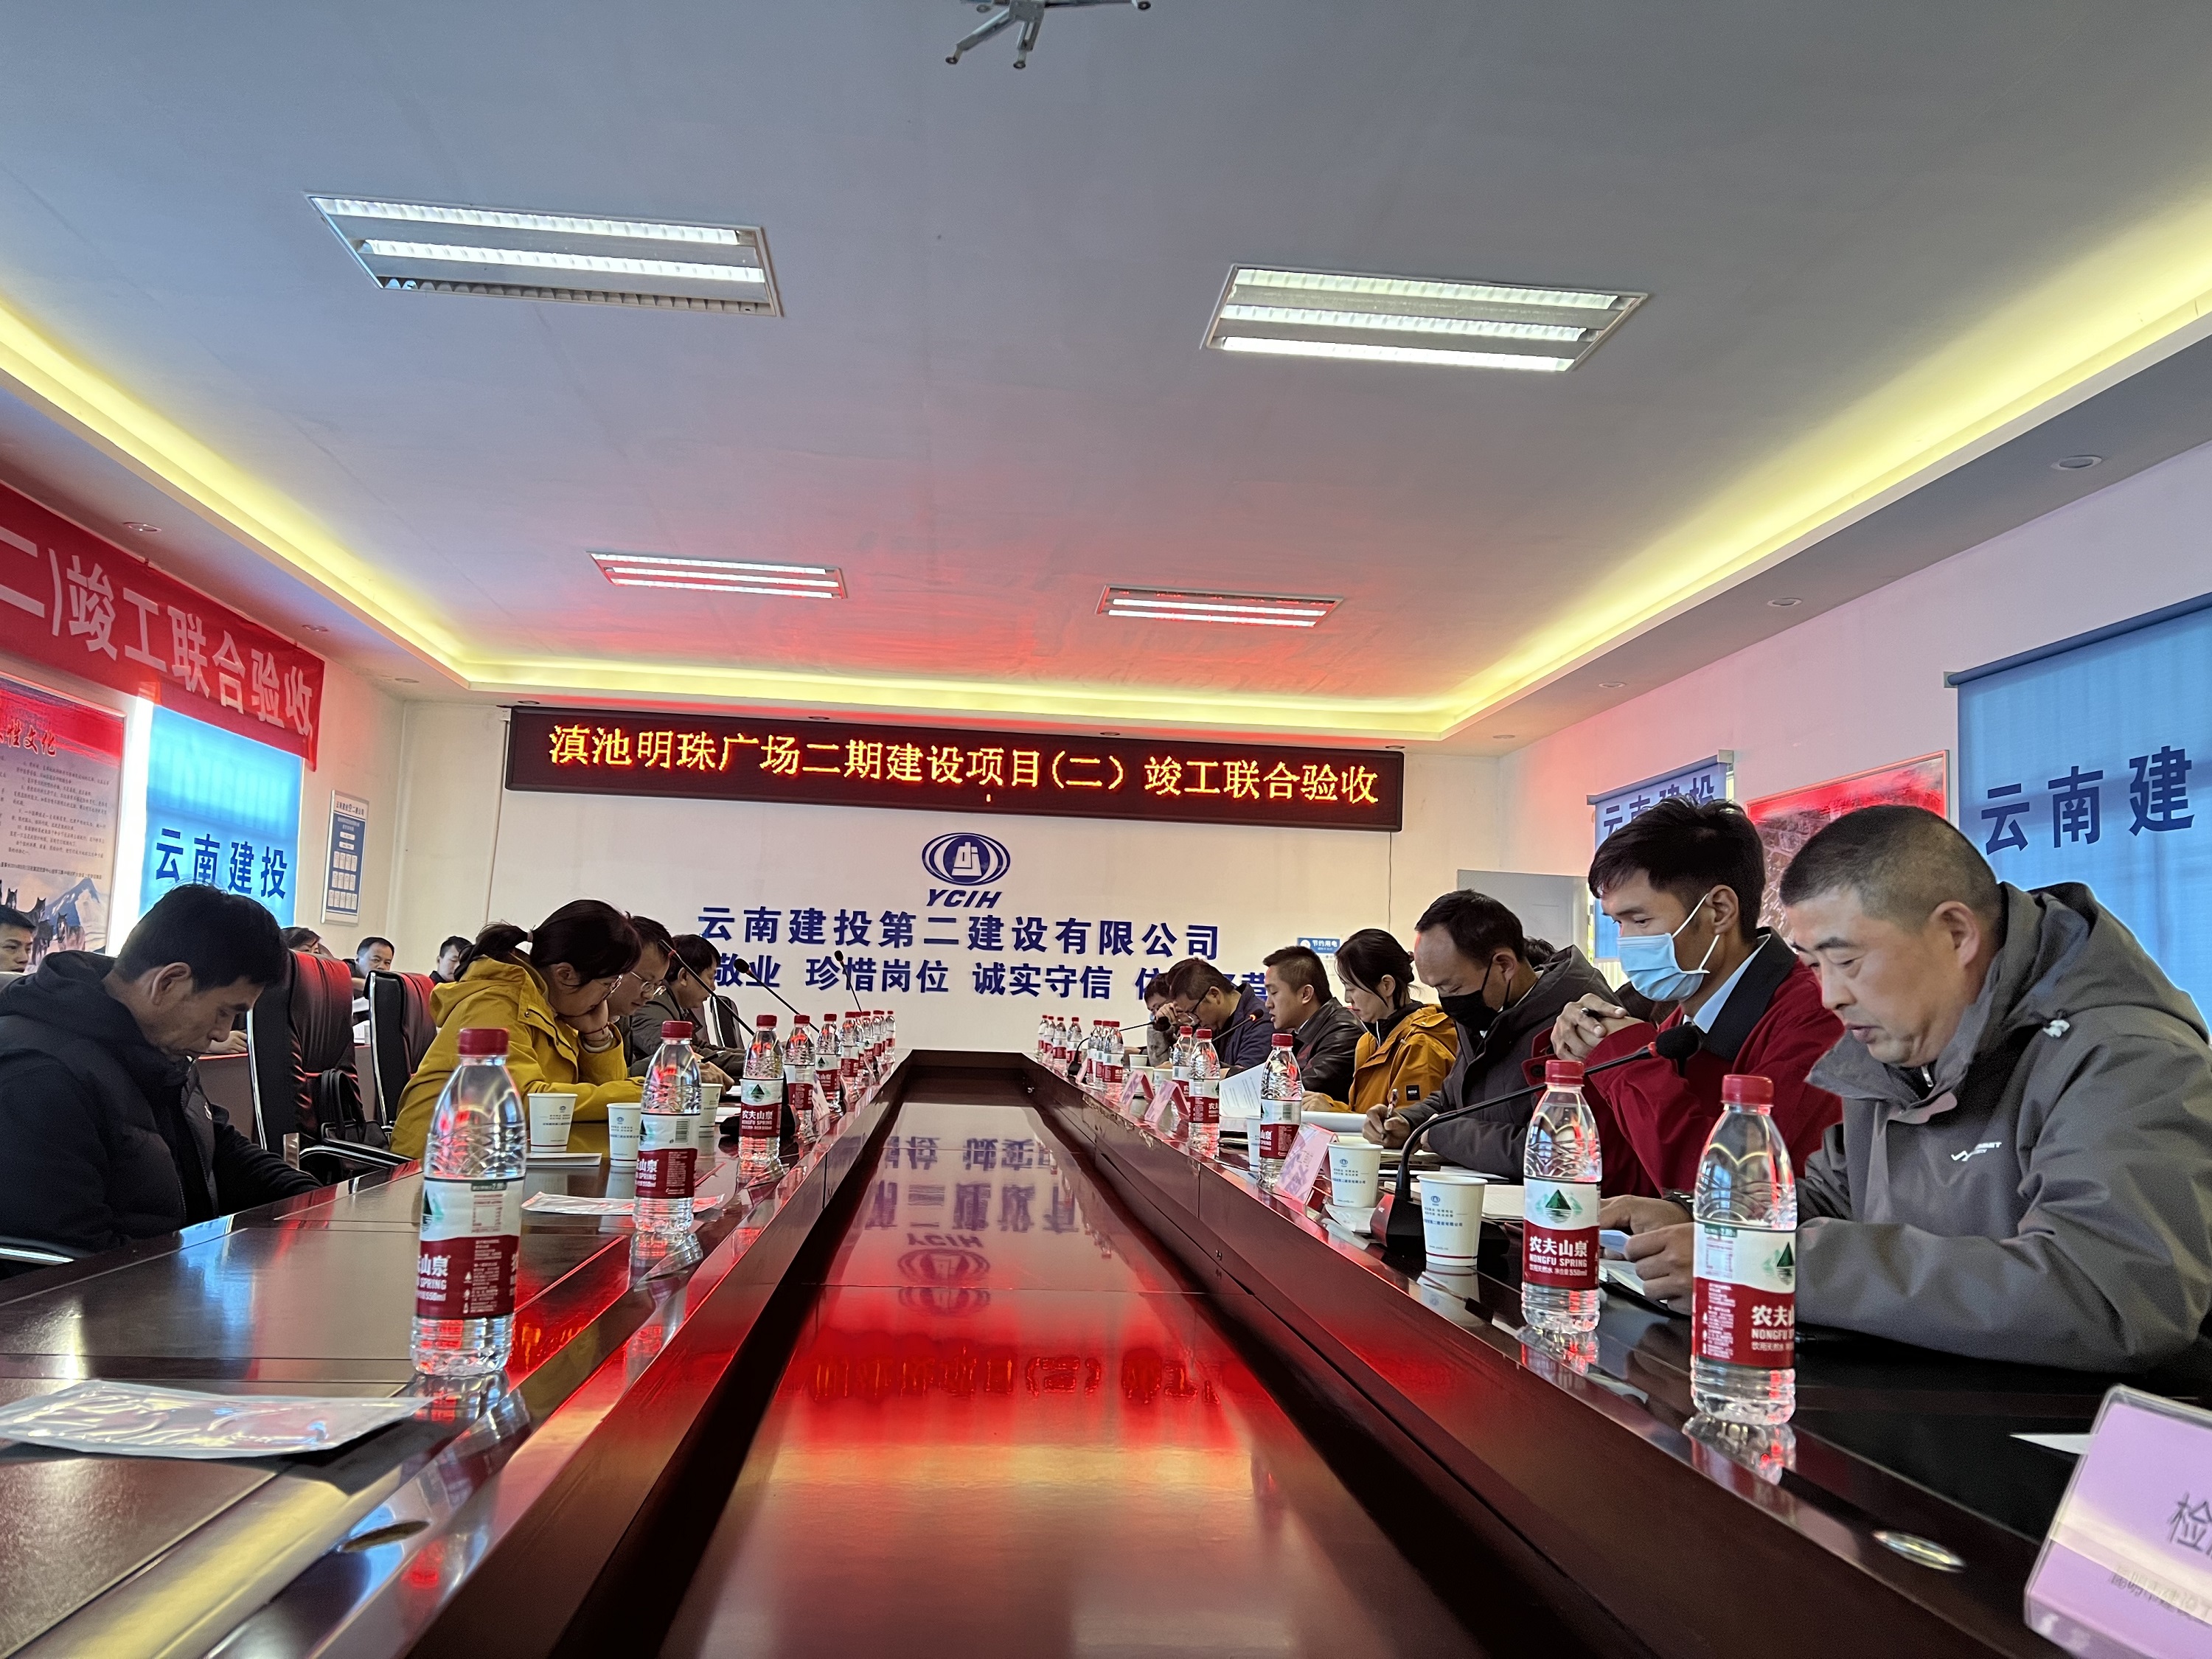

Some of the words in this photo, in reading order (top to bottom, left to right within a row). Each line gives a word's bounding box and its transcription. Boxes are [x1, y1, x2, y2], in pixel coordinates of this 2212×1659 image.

[0, 719, 56, 757] 性文化
[1981, 745, 2195, 855] 云南建
[155, 828, 288, 900] 云南建投
[926, 888, 1002, 908] YCIH
[698, 905, 1219, 960] 云南建投第二建设有限公司
[805, 956, 949, 993] 珍惜岗位
[973, 961, 1113, 1000] 诚实守信
[742, 1110, 773, 1120] 农夫山泉
[1529, 1236, 1587, 1257] 农夫山泉
[1529, 1253, 1557, 1265] NONGFU
[1559, 1258, 1587, 1267] SPRING
[417, 1253, 448, 1277] 山泉
[1751, 1329, 1787, 1340] NONGFU
[2168, 1492, 2212, 1559] 检
